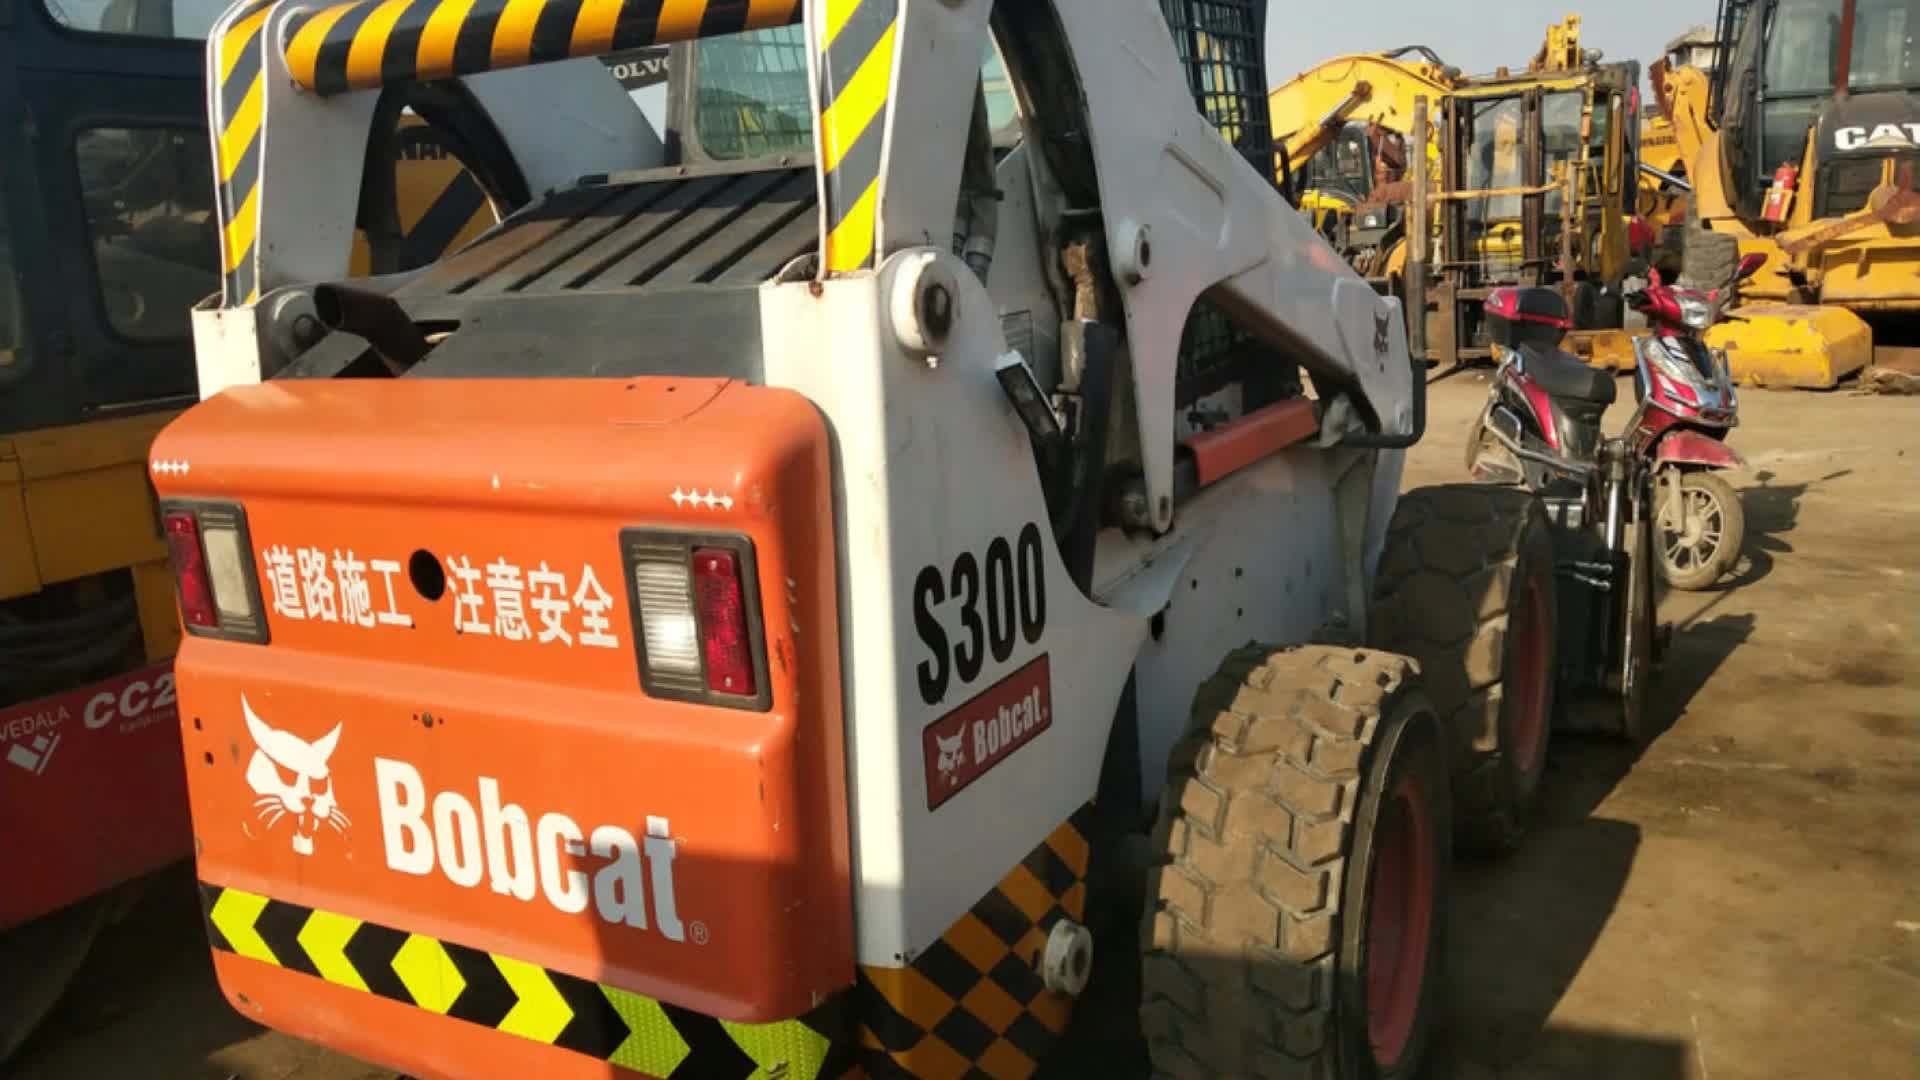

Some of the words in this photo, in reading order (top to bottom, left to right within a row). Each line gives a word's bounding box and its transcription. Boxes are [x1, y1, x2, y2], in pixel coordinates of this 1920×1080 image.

[608, 56, 669, 79] OLV
[262, 544, 413, 628] 道路施工
[446, 555, 619, 648] 注意安全
[913, 522, 1046, 706] S300
[972, 685, 1041, 766] Bobcat
[374, 756, 685, 943] Bobcat
